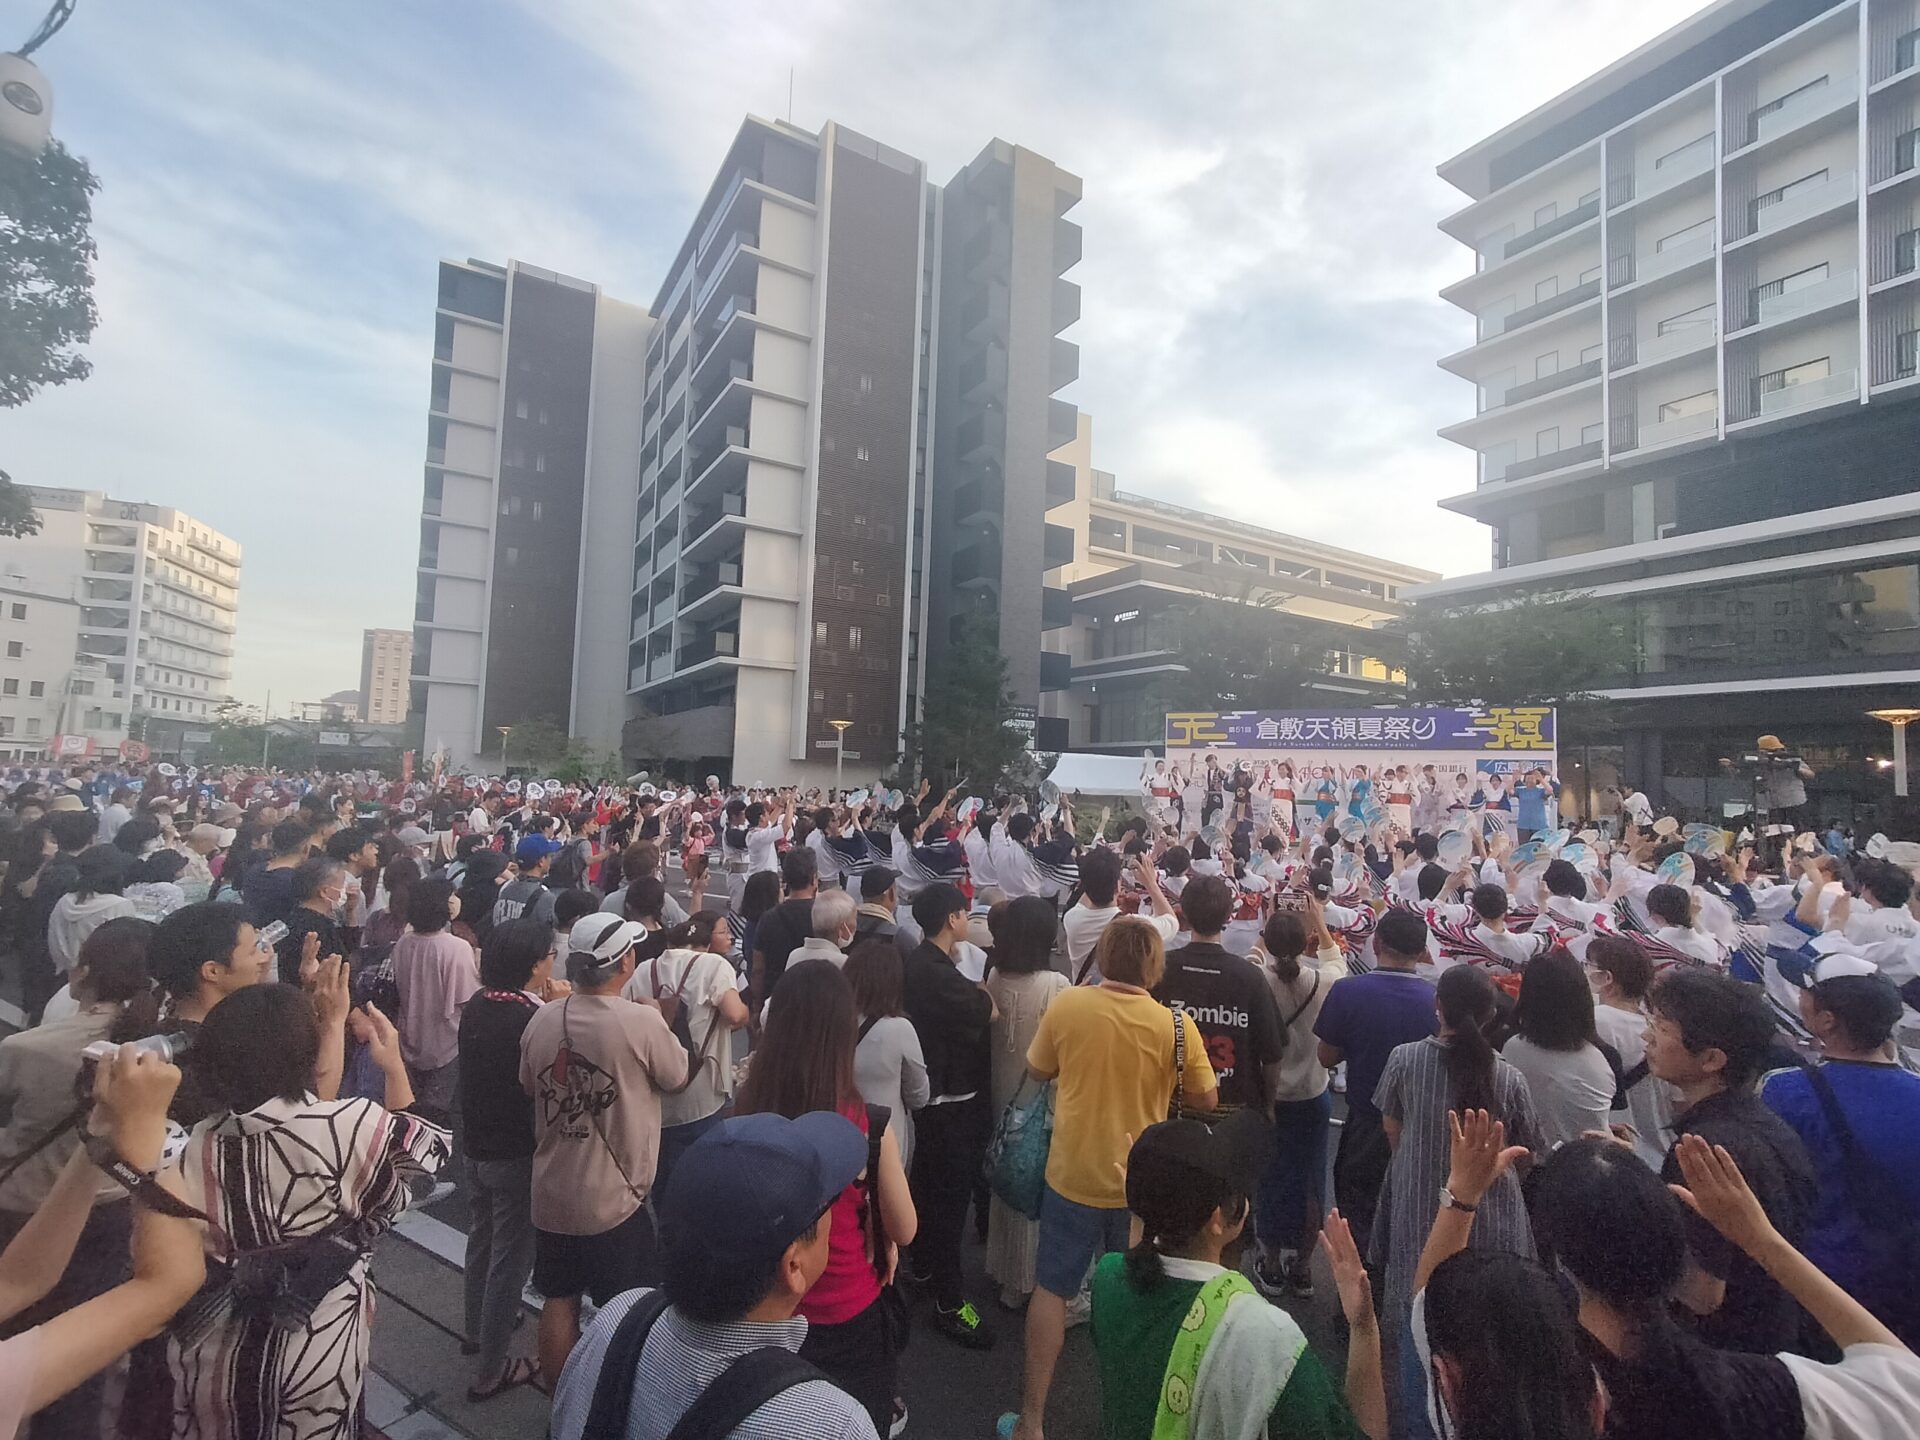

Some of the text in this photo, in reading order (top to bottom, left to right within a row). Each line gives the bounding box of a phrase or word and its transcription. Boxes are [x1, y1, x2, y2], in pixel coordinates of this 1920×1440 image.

[120, 503, 139, 521] JR
[1255, 717, 1436, 740] 倉敷天領夏祭り
[113, 1162, 140, 1184] Canon
